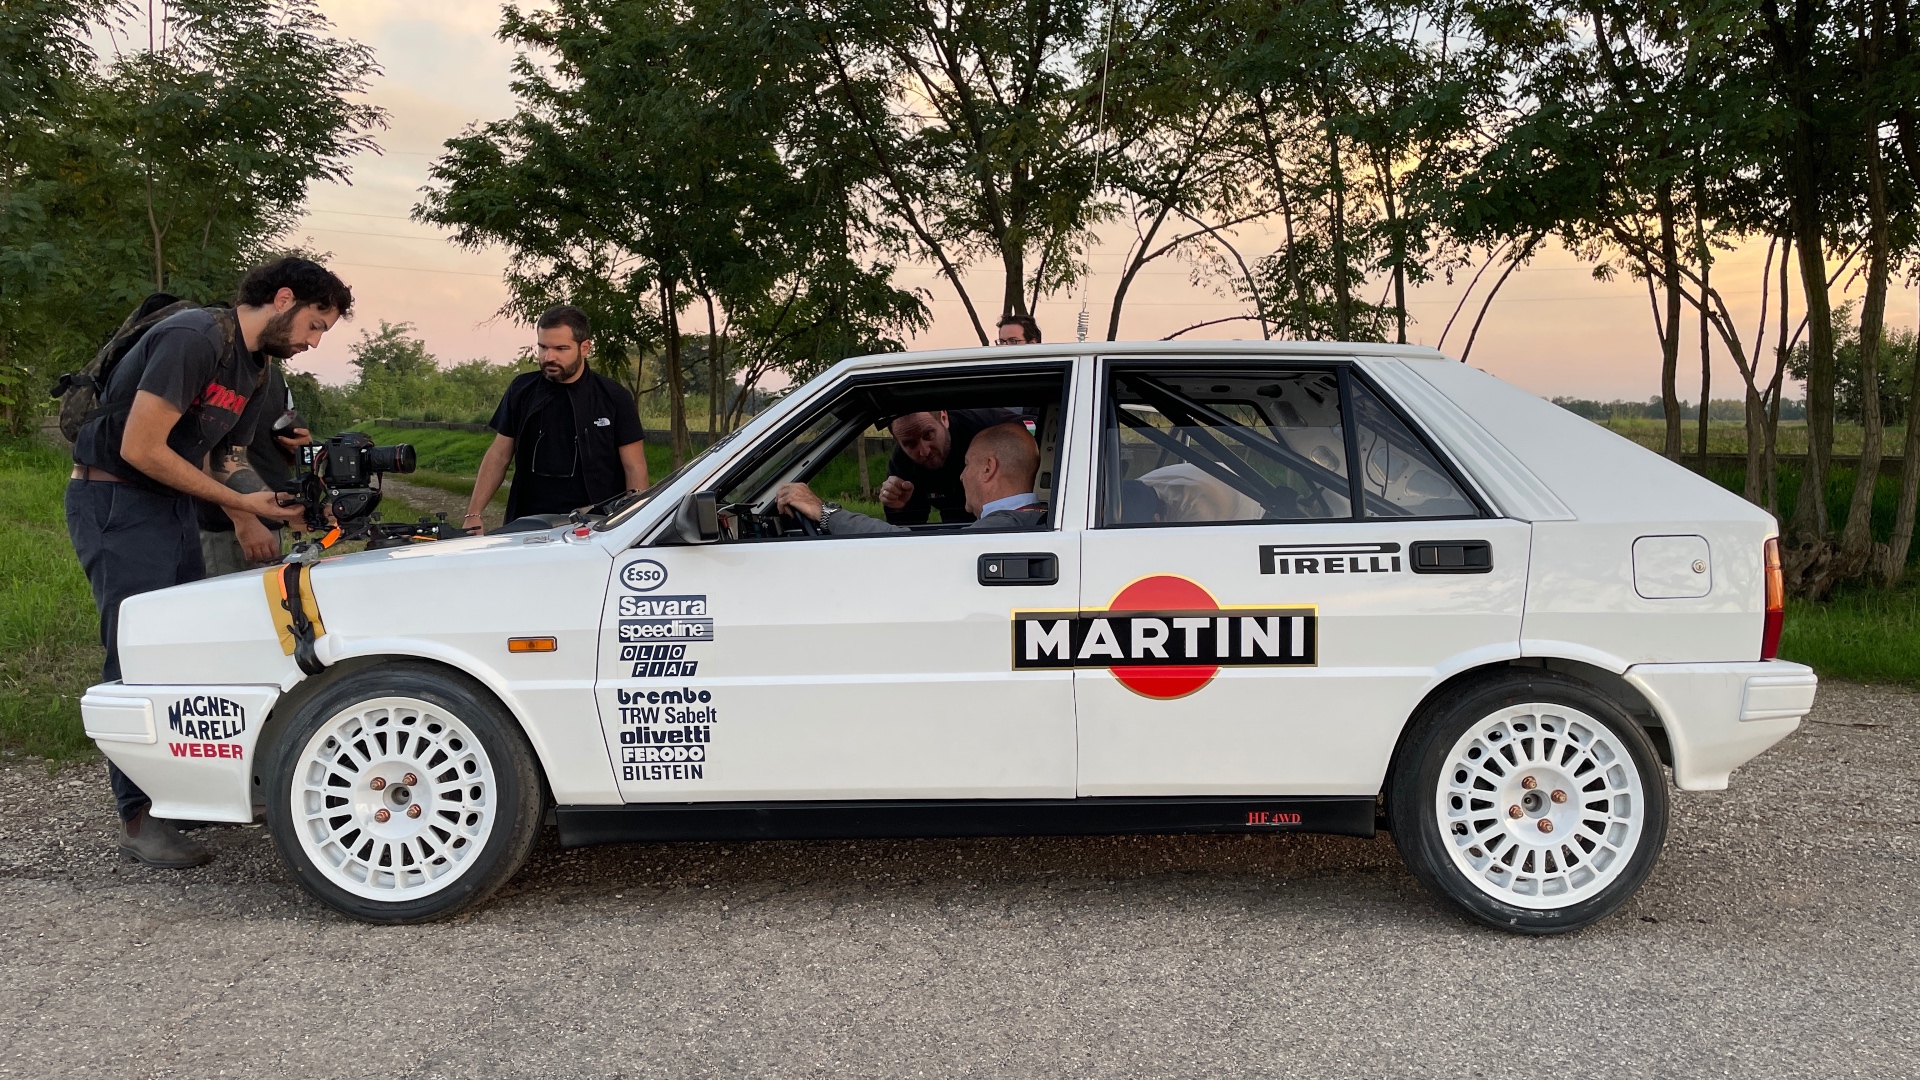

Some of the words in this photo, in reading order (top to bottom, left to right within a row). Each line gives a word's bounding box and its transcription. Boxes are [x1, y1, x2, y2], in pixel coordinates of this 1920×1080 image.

[1259, 542, 1402, 574] PIRELLI
[627, 567, 661, 581] Esso
[620, 596, 706, 616] Savara
[620, 620, 705, 641] speedline
[1025, 616, 1305, 660] MARTINI
[623, 646, 683, 660] OLIO
[635, 663, 695, 676] FIAT
[617, 687, 712, 705] brembo
[618, 706, 660, 724] TRW
[664, 706, 718, 724] Sabelt
[620, 726, 711, 744] olivetti
[168, 742, 244, 760] WEBER
[622, 746, 704, 763] FERODO
[623, 764, 704, 780] BILSTEIN
[1247, 811, 1270, 824] HF
[1271, 813, 1301, 824] 4WD
